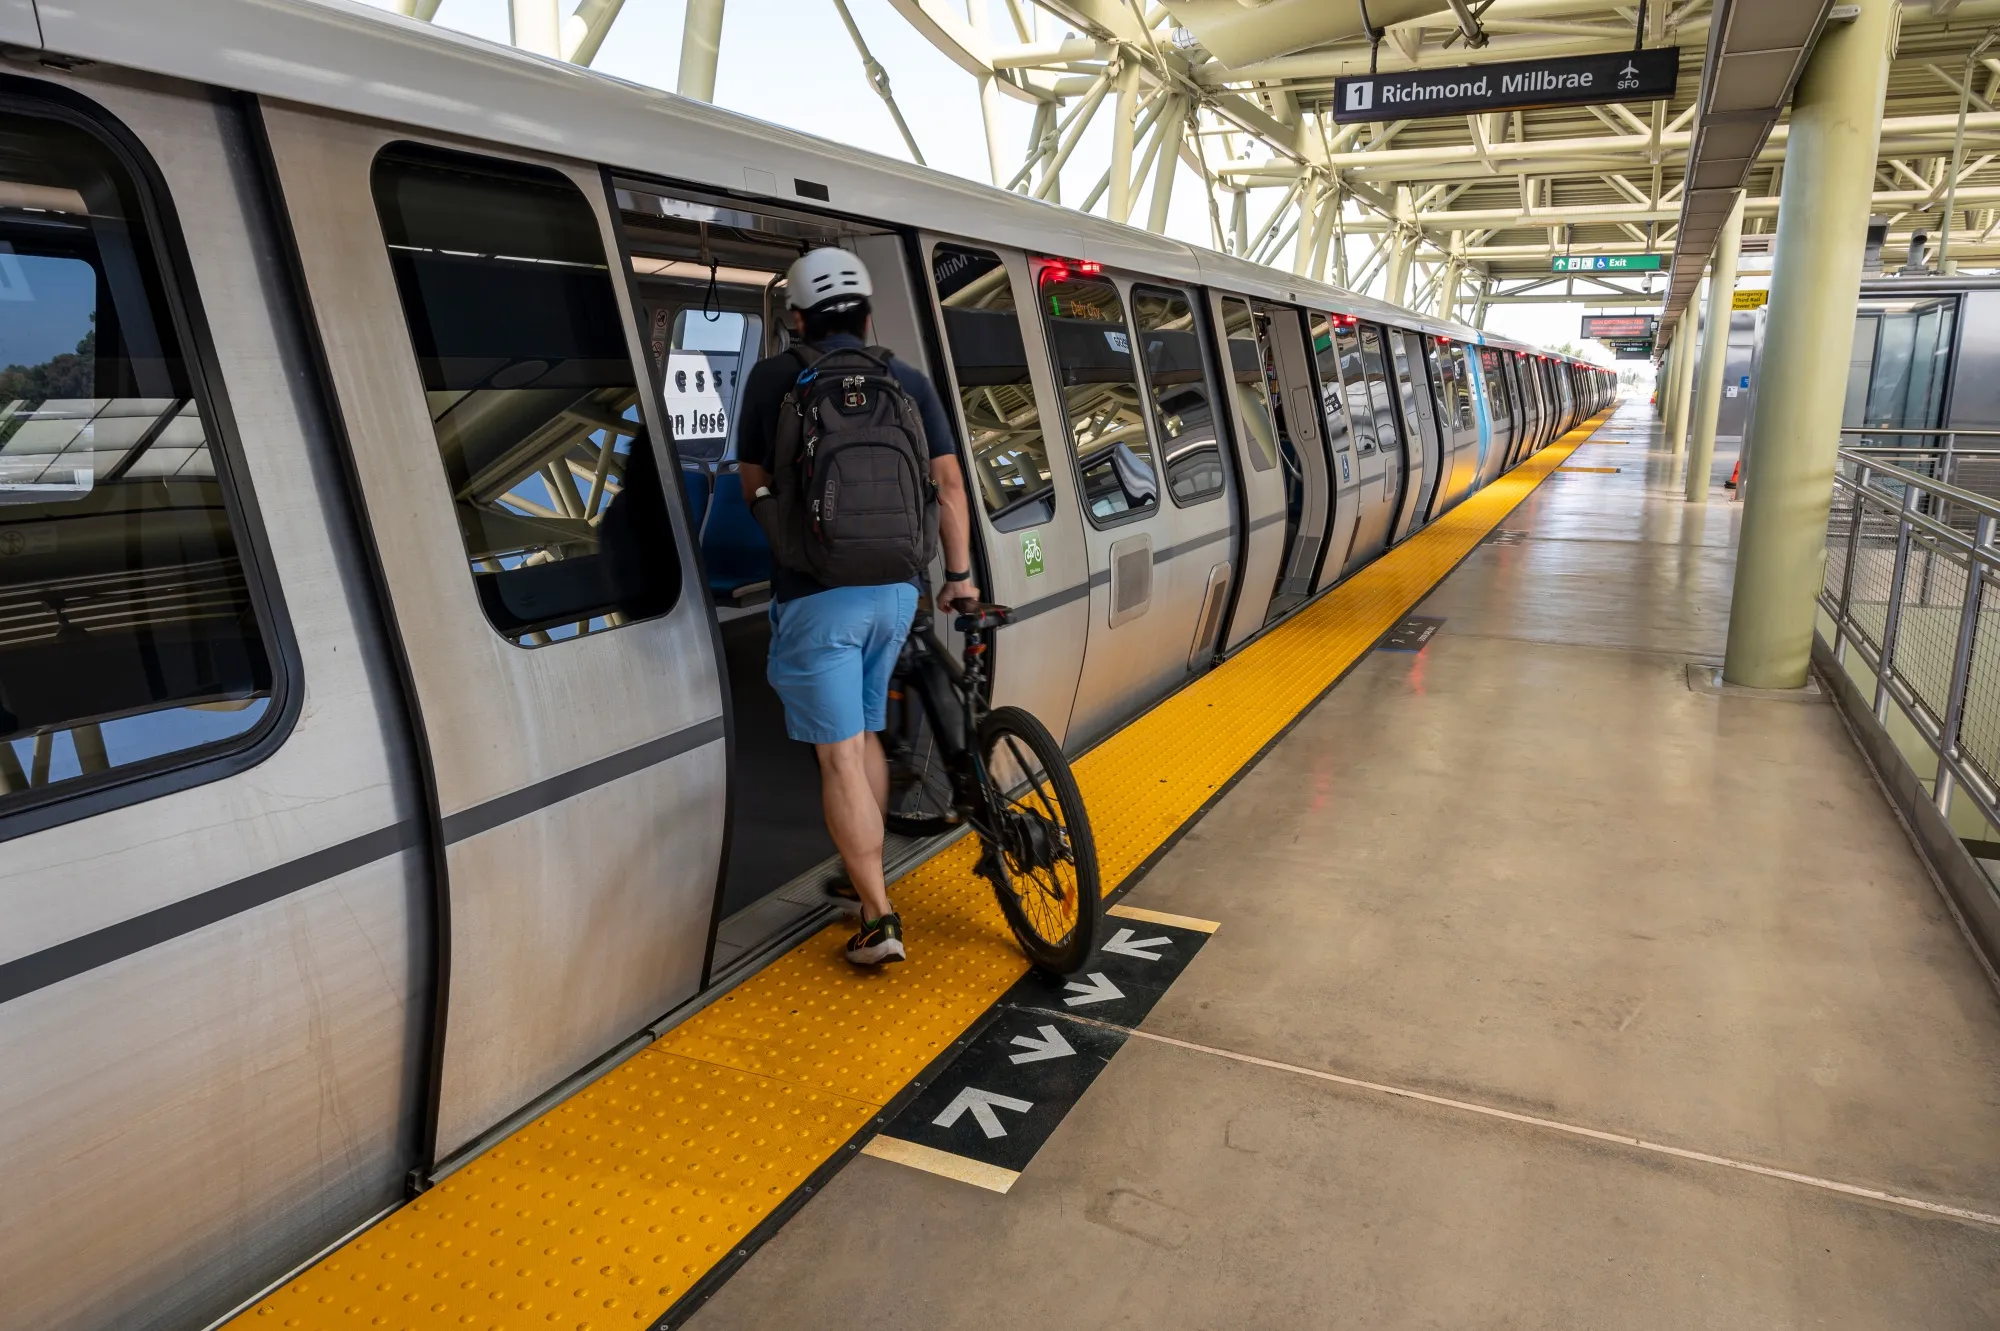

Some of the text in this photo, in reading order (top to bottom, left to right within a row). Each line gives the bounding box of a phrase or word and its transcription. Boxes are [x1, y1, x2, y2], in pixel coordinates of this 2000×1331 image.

[1353, 70, 1593, 107] 1 Richmond, Millbrae
[1617, 79, 1639, 90] SFO
[1609, 258, 1627, 267] Exit
[692, 407, 725, 434] José
